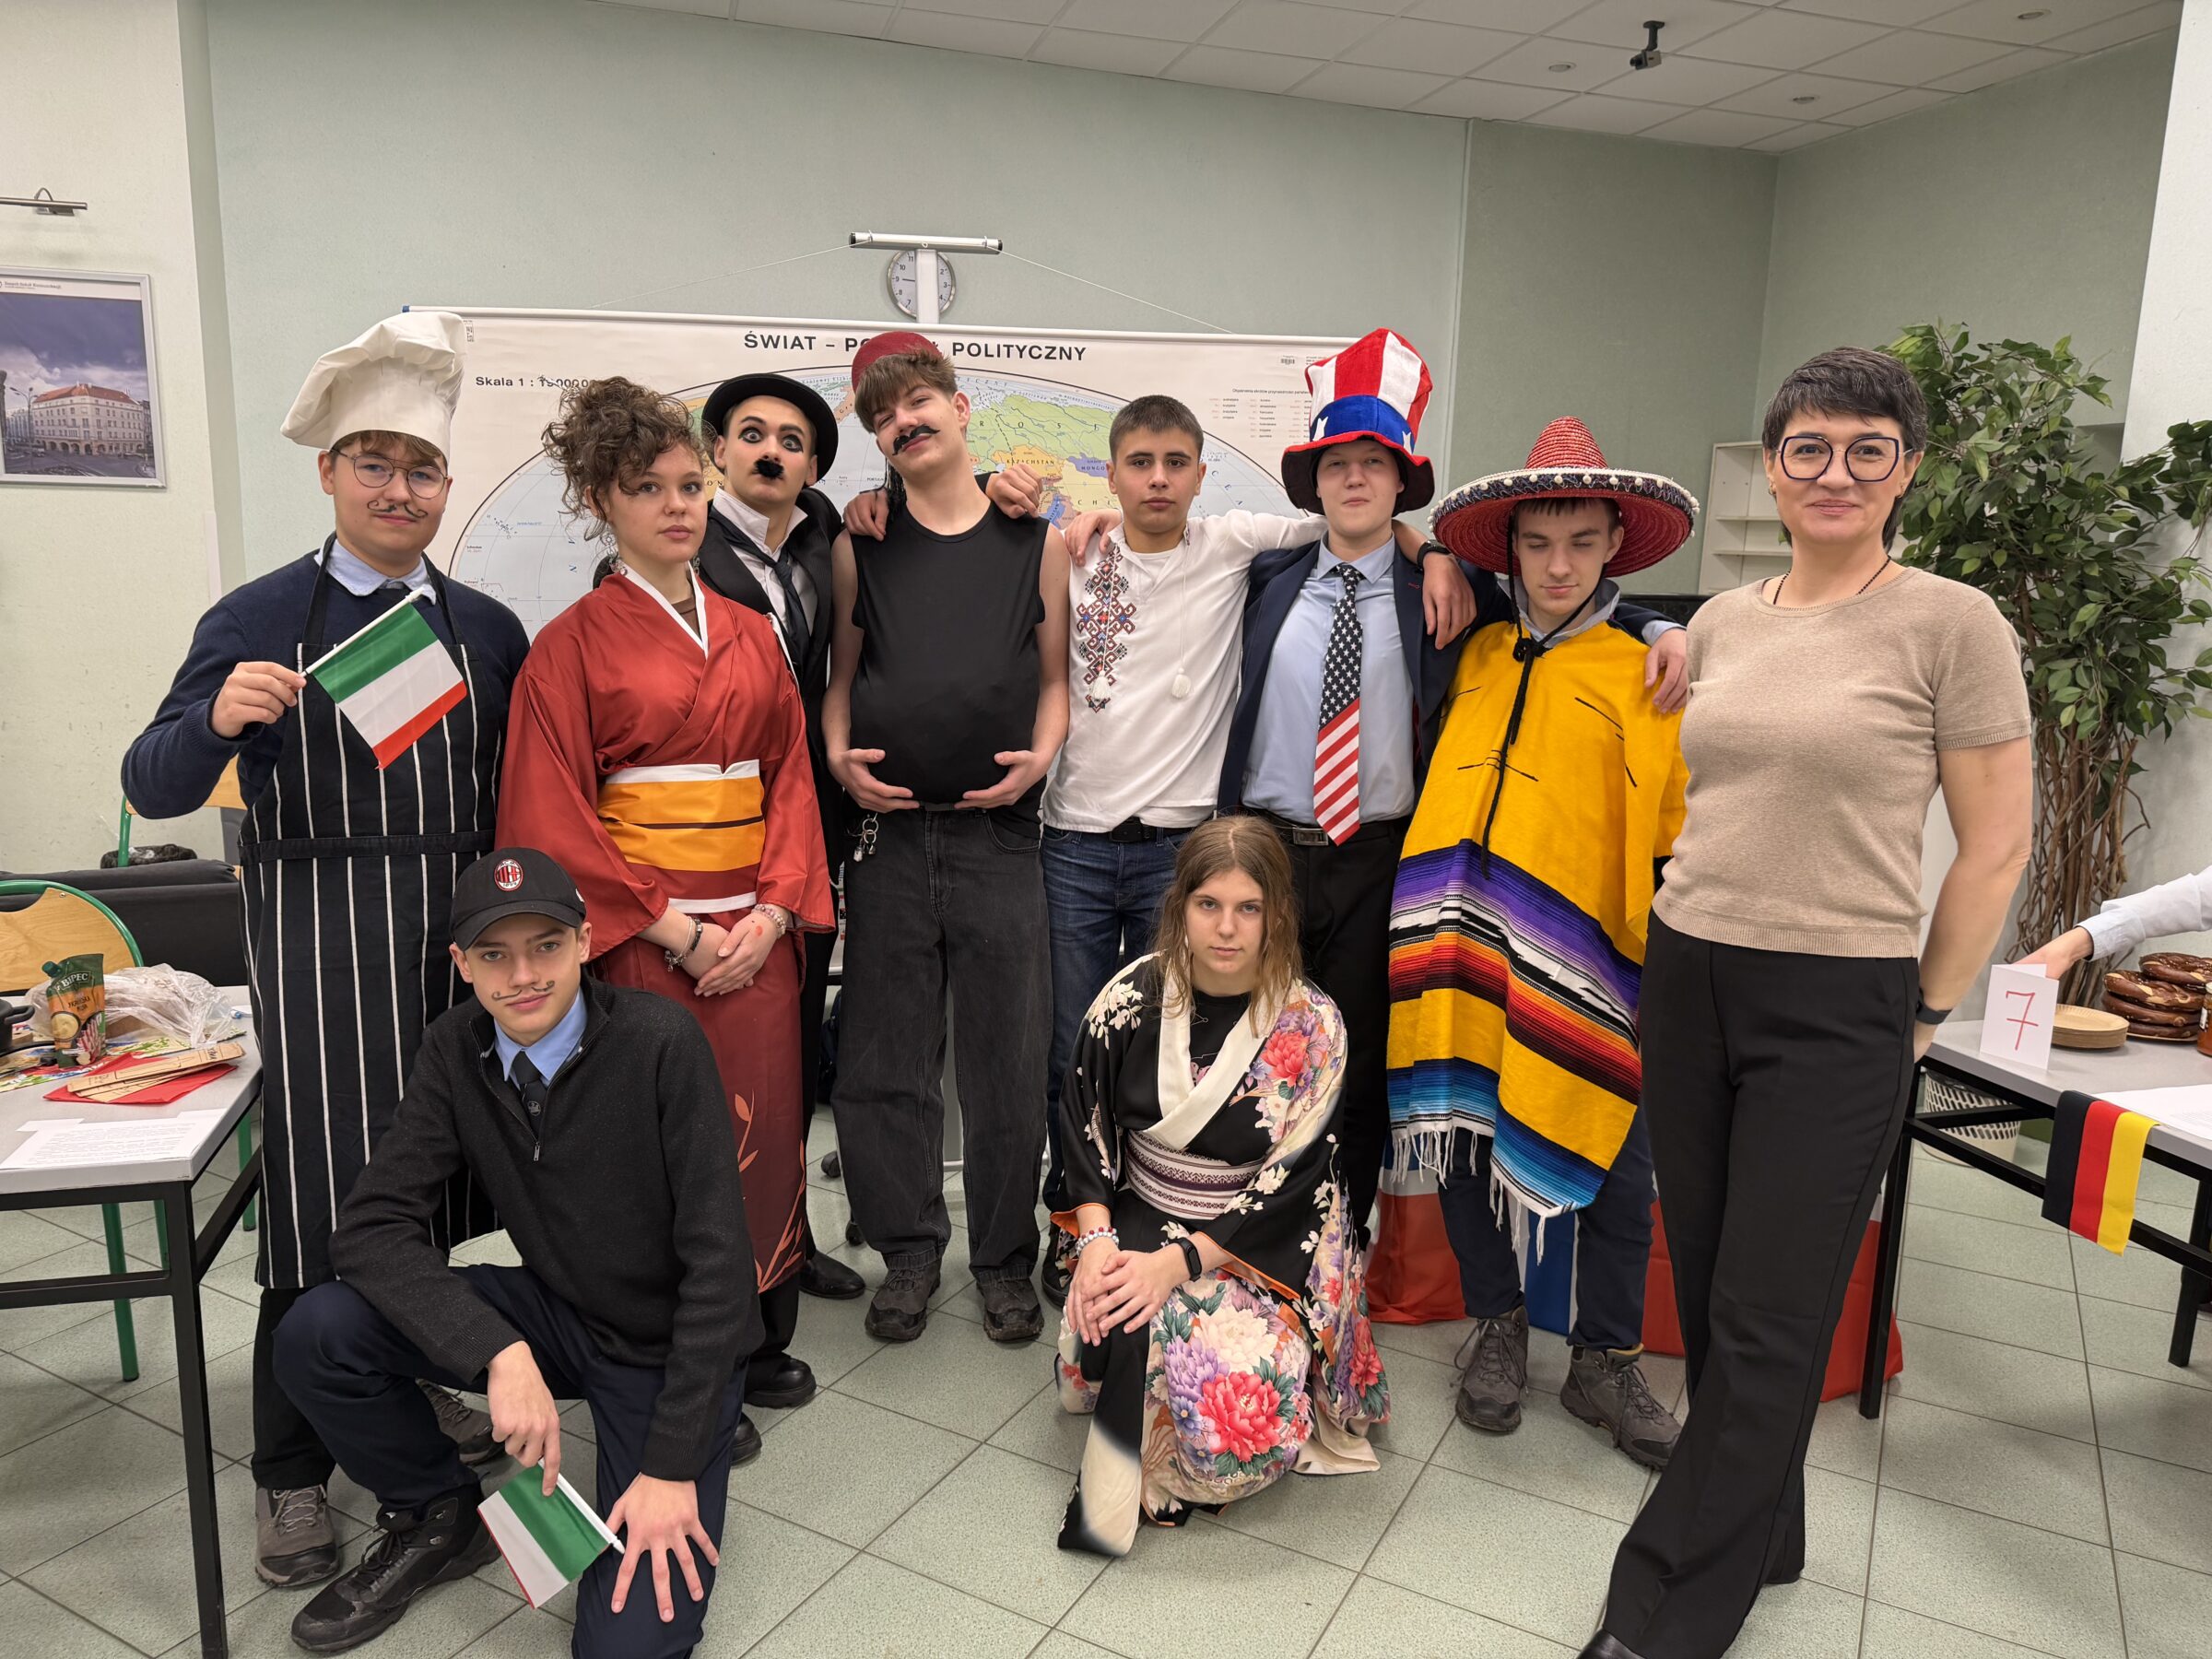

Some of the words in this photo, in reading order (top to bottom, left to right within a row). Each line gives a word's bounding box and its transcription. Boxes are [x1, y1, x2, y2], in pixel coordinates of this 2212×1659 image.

[744, 331, 817, 350] ŚWIAT
[952, 342, 1087, 360] POLITYCZNY
[476, 376, 513, 386] Skala
[519, 378, 524, 386] 1
[2005, 990, 2039, 1051] 7
